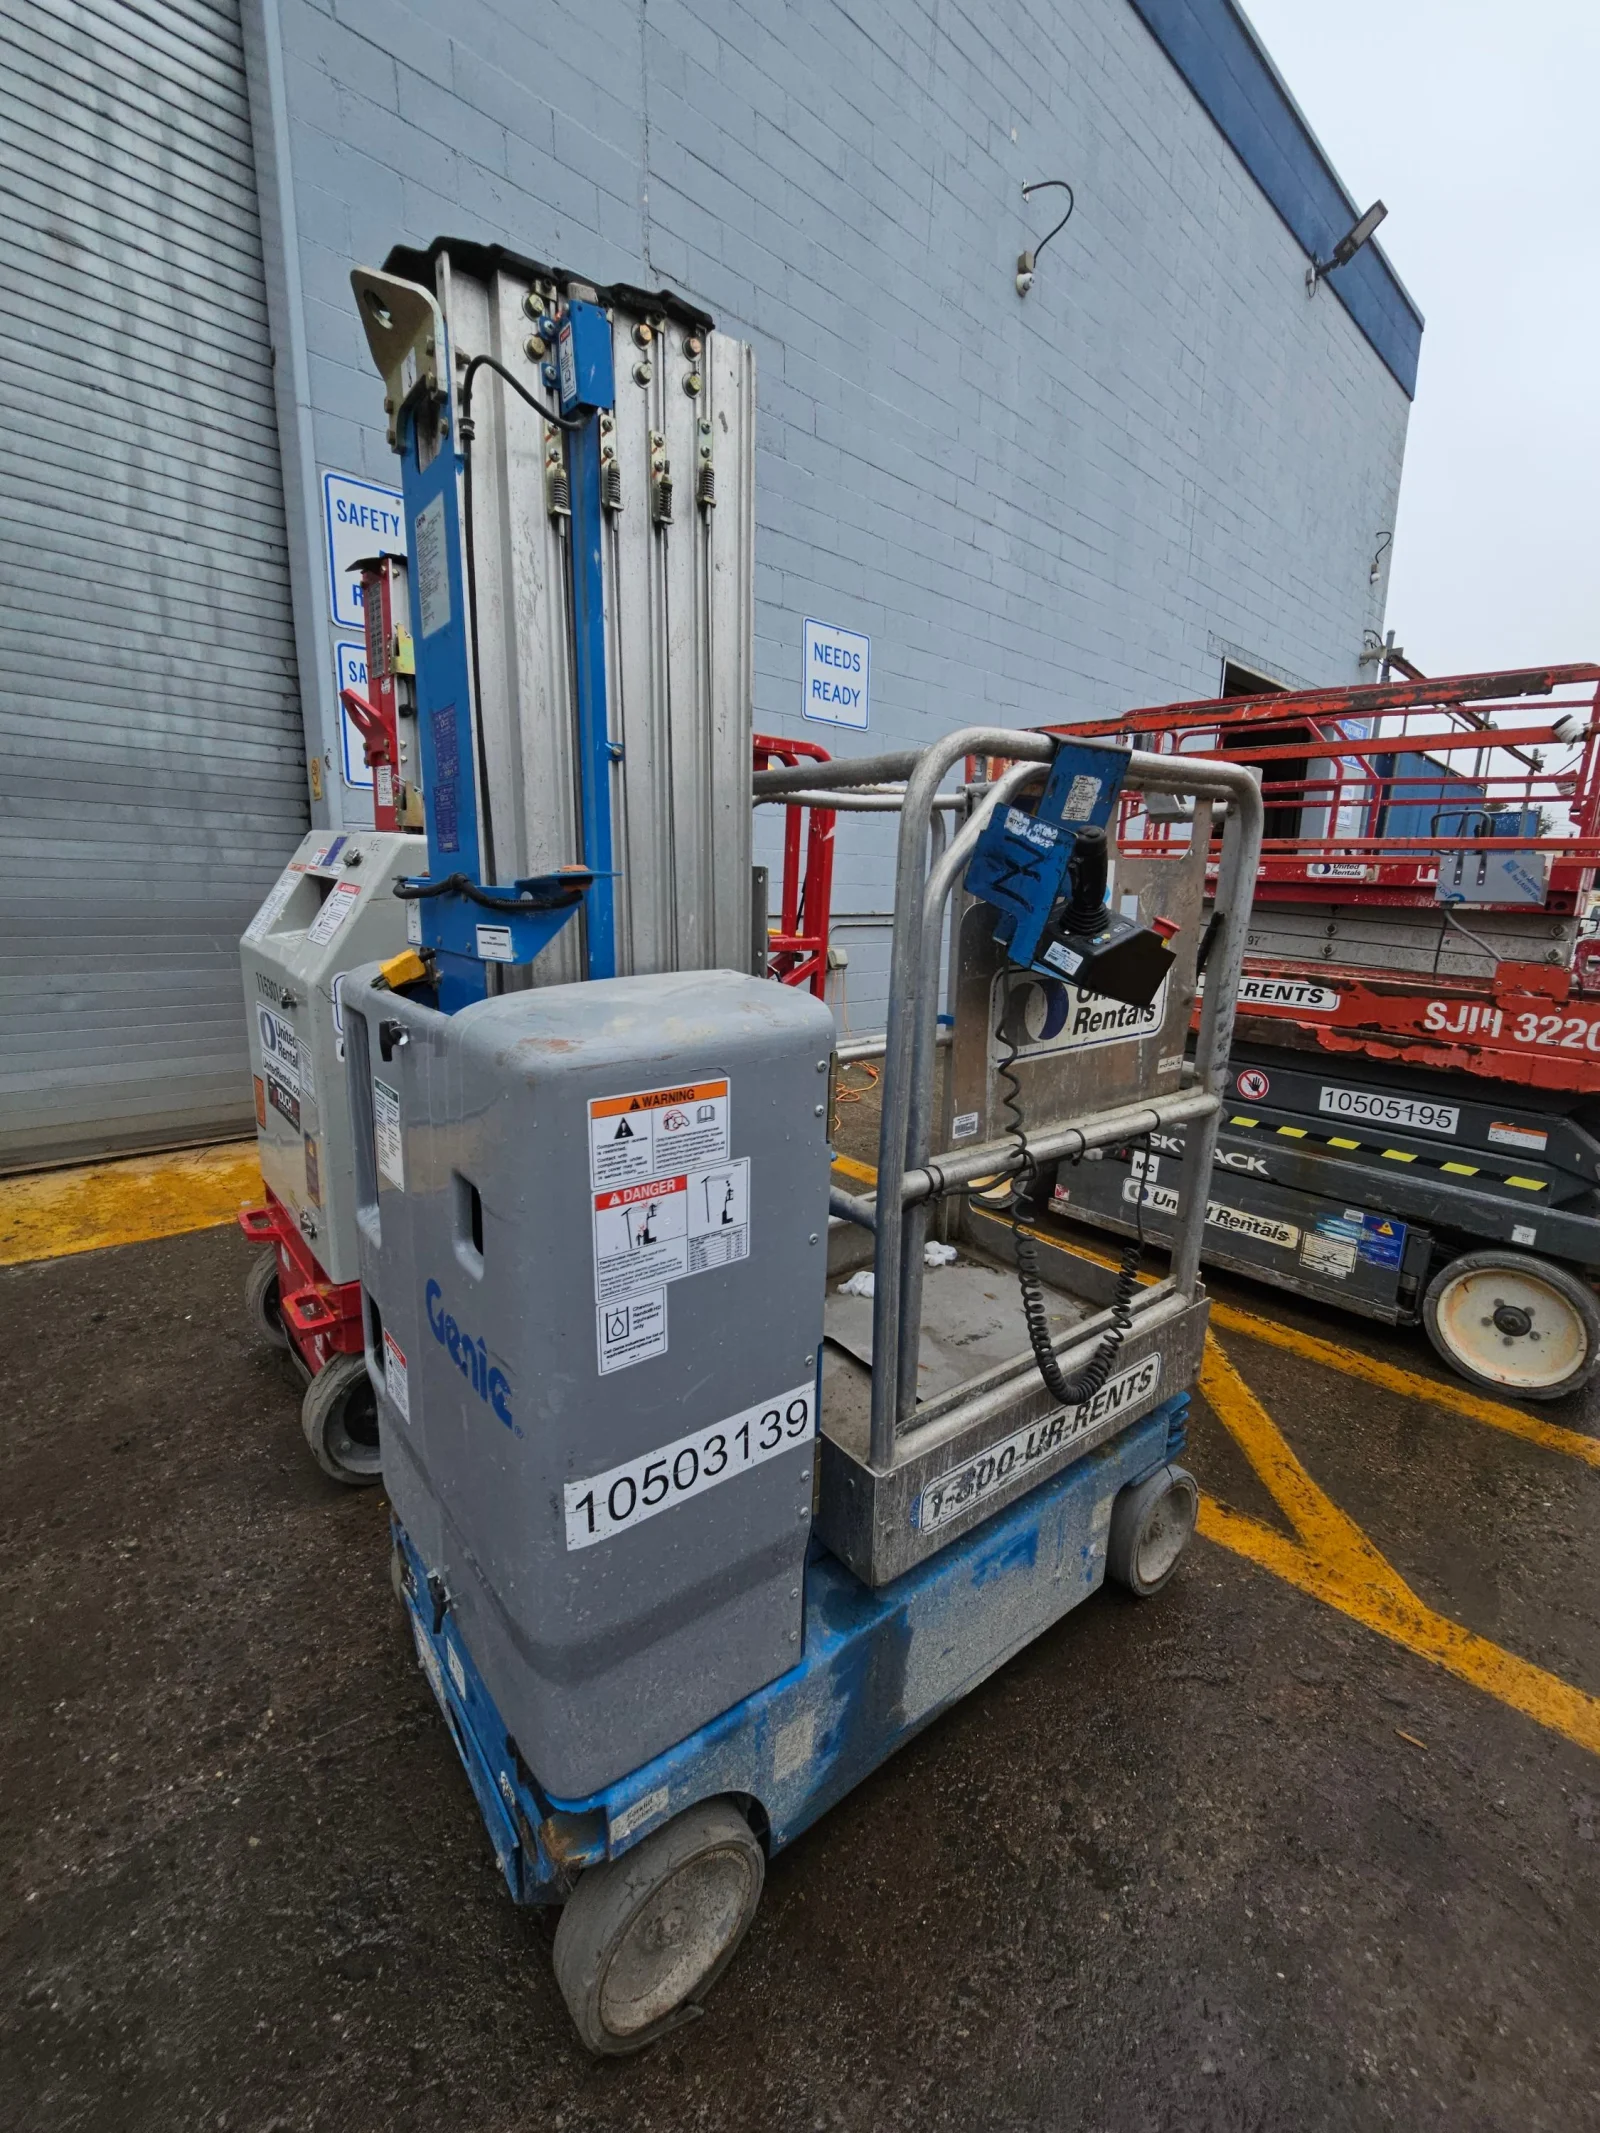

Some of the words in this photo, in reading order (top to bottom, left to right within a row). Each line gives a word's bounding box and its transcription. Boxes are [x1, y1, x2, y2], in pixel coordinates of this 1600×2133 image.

[337, 499, 400, 537] SAFETY
[814, 641, 861, 673] NEEDS
[812, 678, 861, 708] READY
[1071, 1003, 1156, 1036] Rentals
[641, 1088, 696, 1108] WARNING
[1323, 1089, 1454, 1131] 10505195
[622, 1178, 677, 1203] DANGER
[1215, 1209, 1292, 1243] Rentals
[425, 1277, 513, 1430] Genie
[575, 1398, 809, 1534] 10503139
